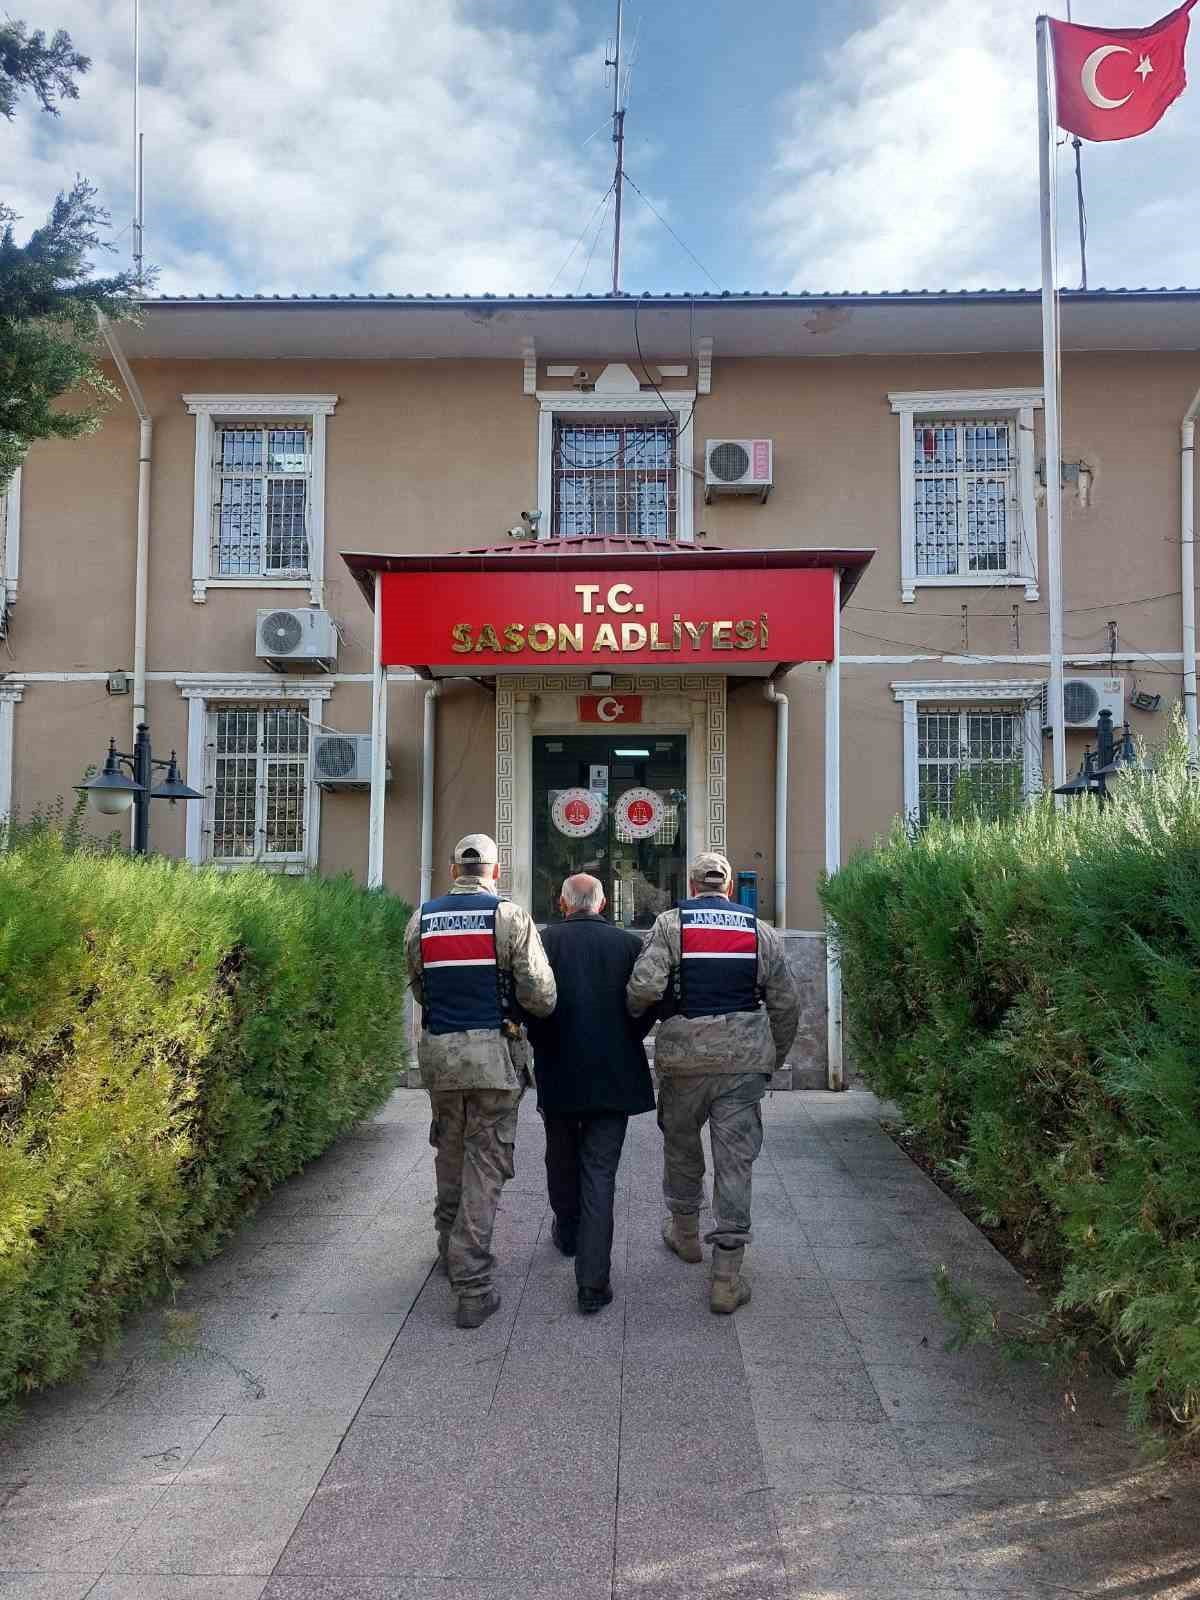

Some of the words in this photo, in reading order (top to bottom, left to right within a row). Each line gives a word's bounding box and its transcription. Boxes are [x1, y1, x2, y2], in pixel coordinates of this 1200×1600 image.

[575, 583, 645, 613] T.C.
[451, 622, 585, 653] SASON
[592, 612, 769, 652] ADLİYESİ
[427, 915, 487, 932] JANDARMA
[690, 912, 748, 928] JANDARMA
